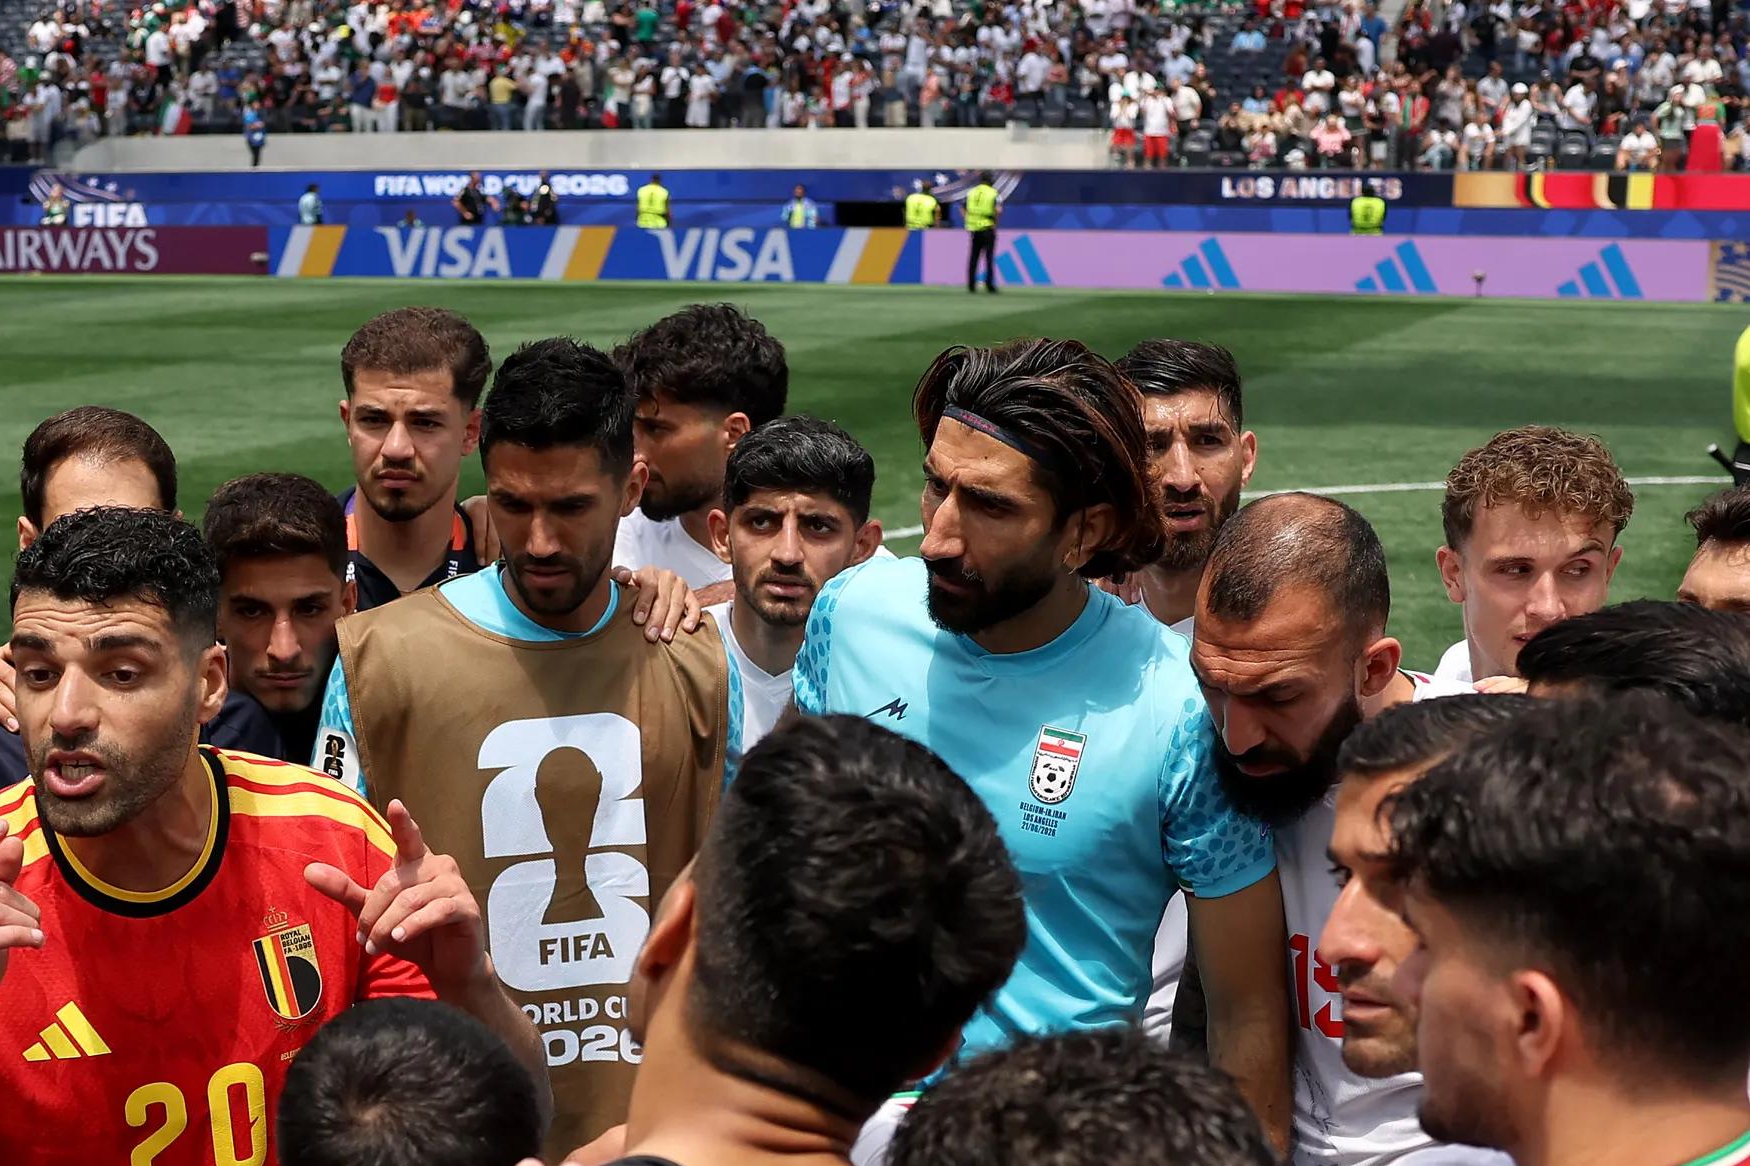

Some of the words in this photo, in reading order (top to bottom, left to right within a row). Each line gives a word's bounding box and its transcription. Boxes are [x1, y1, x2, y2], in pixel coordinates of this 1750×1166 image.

[374, 174, 421, 196] FIFA
[422, 174, 504, 195] WOD
[550, 174, 629, 195] 2026
[1221, 176, 1275, 199] LOS
[73, 203, 147, 227] FIFA
[375, 226, 512, 278] VISA
[646, 227, 796, 281] VISA
[1023, 812, 1034, 823] LOS
[1033, 815, 1059, 829] ANGELES
[280, 929, 301, 941] ROYAL
[282, 934, 311, 948] BELGIAN
[538, 932, 615, 966] FIFA
[521, 998, 599, 1025] ORLD
[541, 1024, 645, 1066] 026
